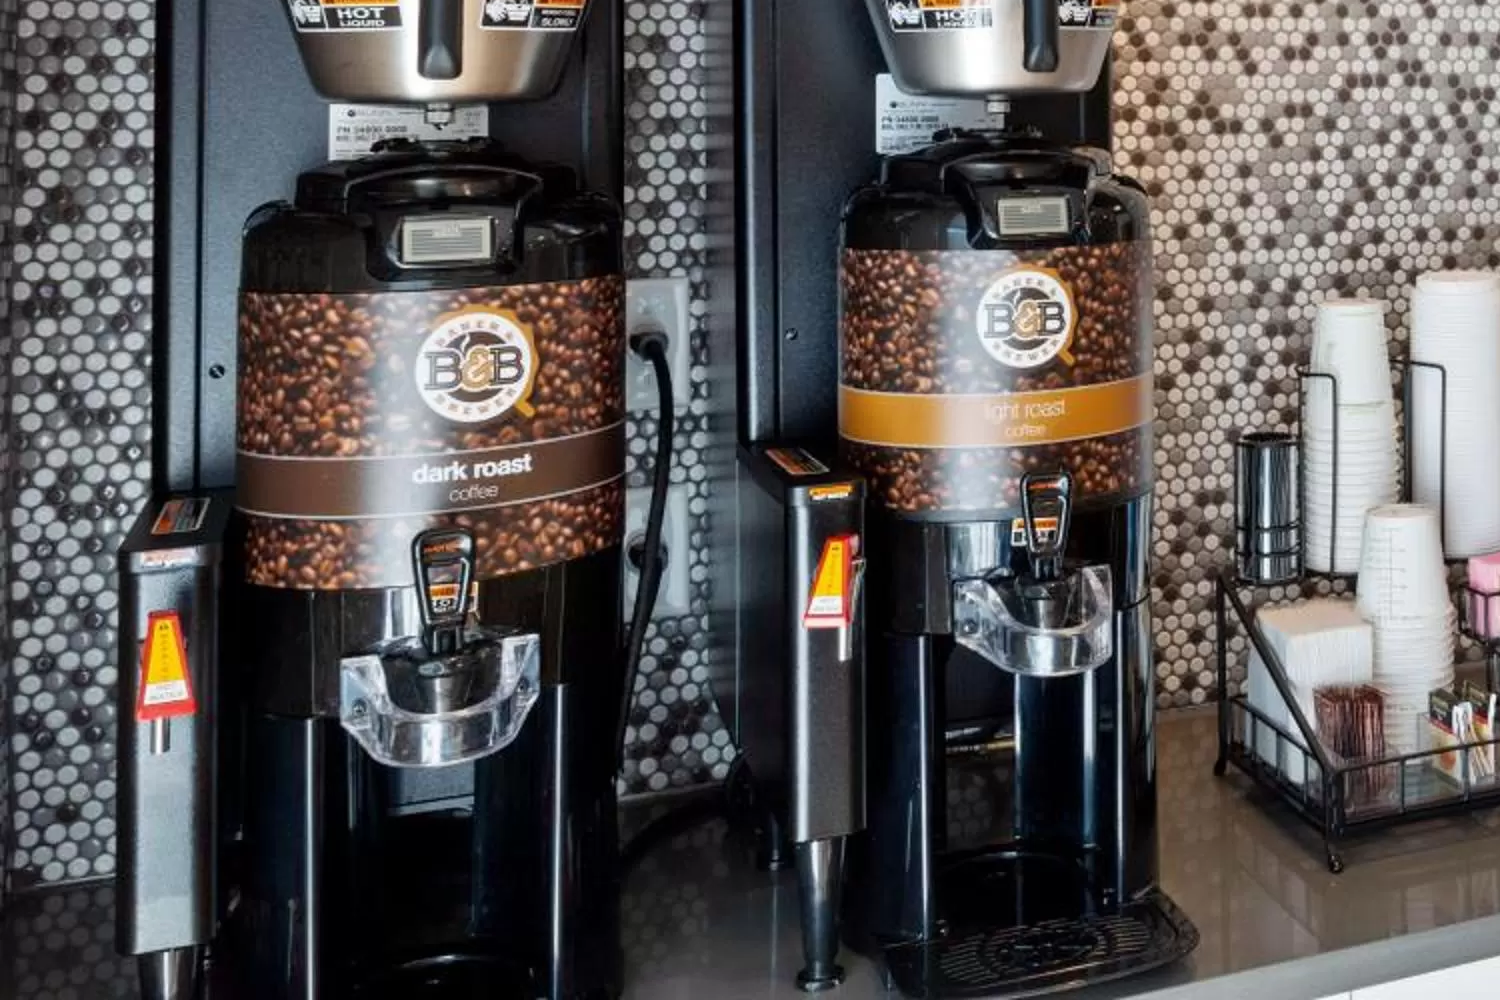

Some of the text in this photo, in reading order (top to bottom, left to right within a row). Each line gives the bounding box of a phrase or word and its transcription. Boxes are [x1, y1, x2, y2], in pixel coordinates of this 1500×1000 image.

[337, 6, 385, 19] HOT
[423, 344, 525, 391] B&B
[411, 453, 533, 484] dark roast
[448, 484, 500, 502] coffee
